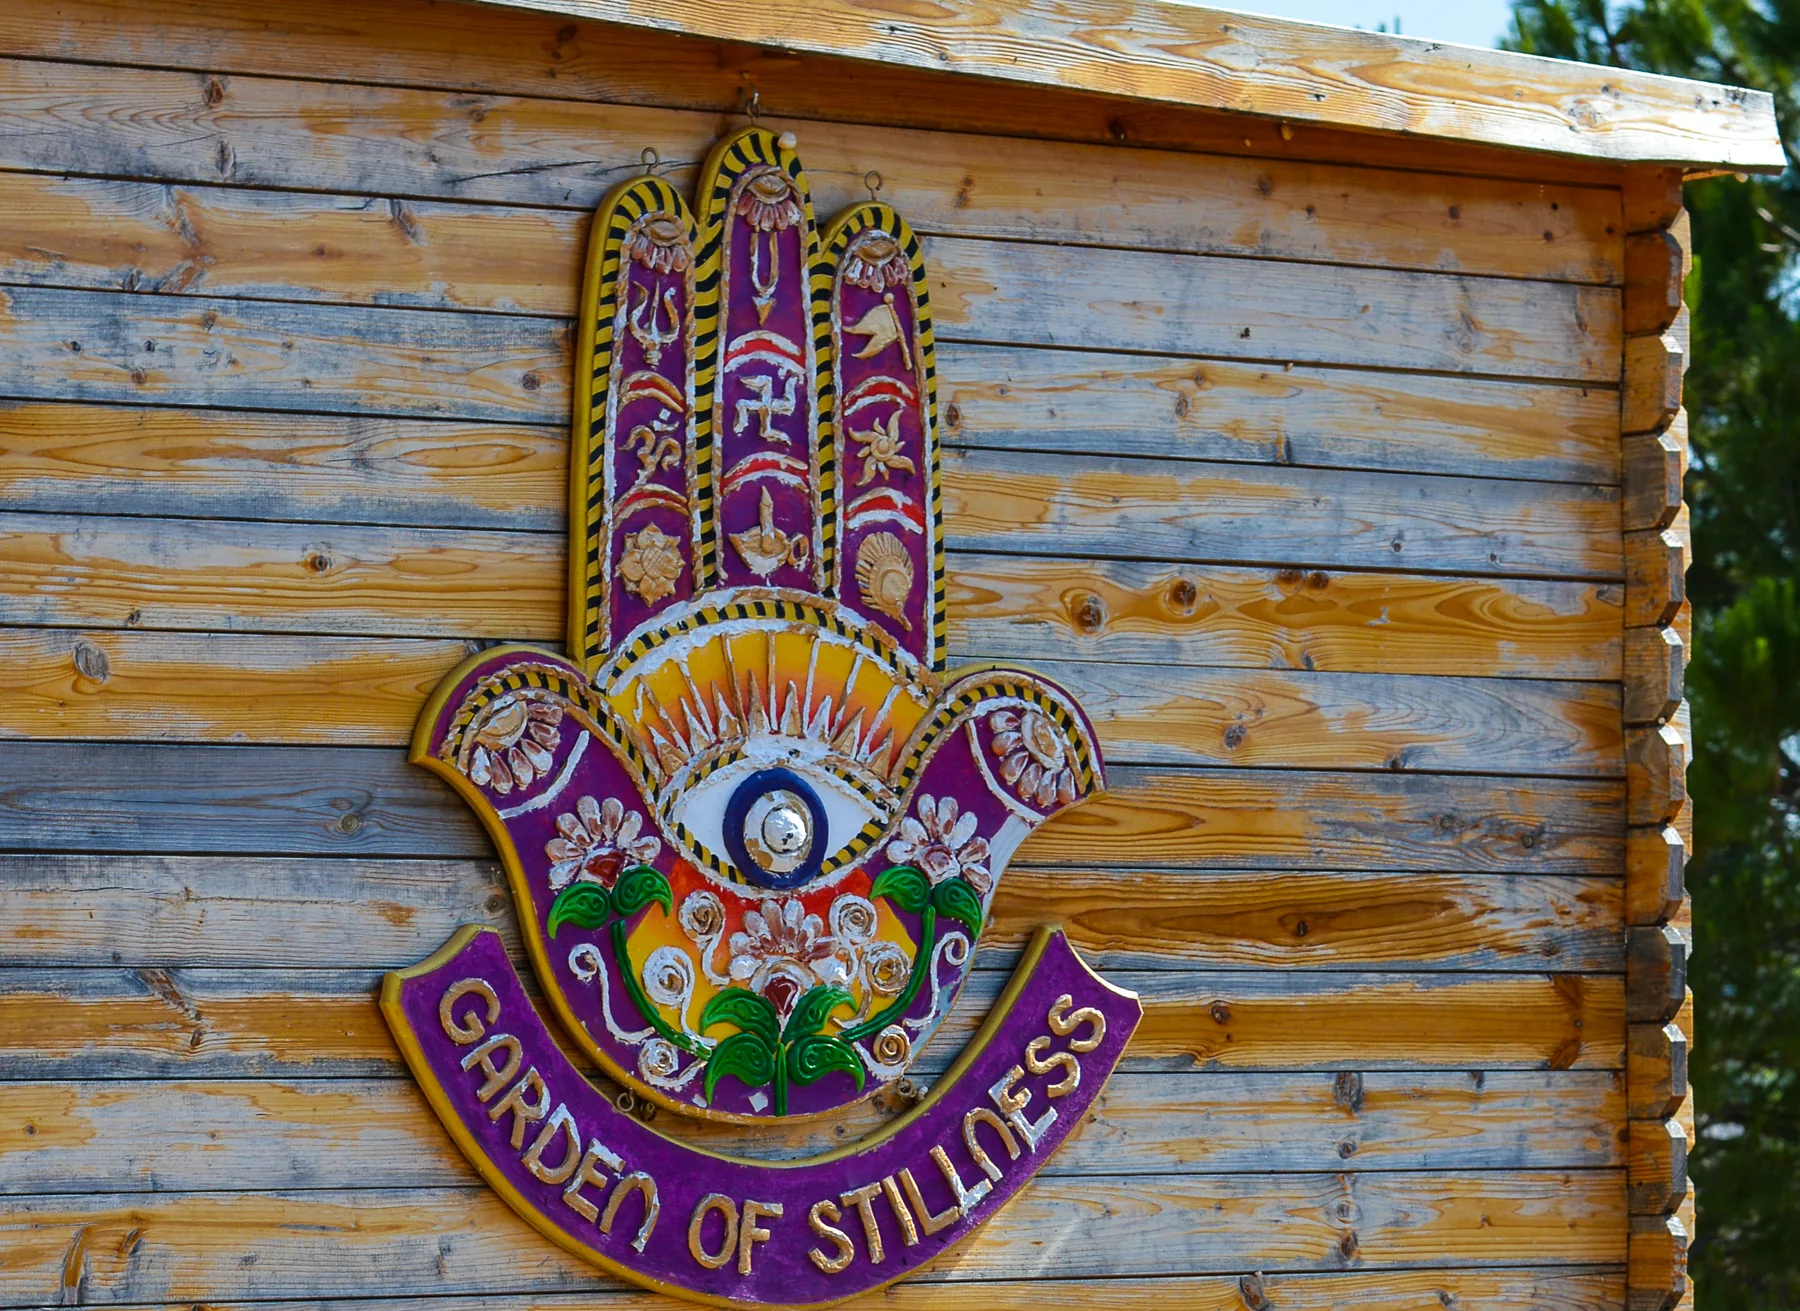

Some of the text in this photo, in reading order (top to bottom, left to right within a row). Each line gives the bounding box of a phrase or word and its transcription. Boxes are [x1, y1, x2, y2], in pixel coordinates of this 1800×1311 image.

[439, 977, 1106, 1276] GARDEN OF STILLNESS
